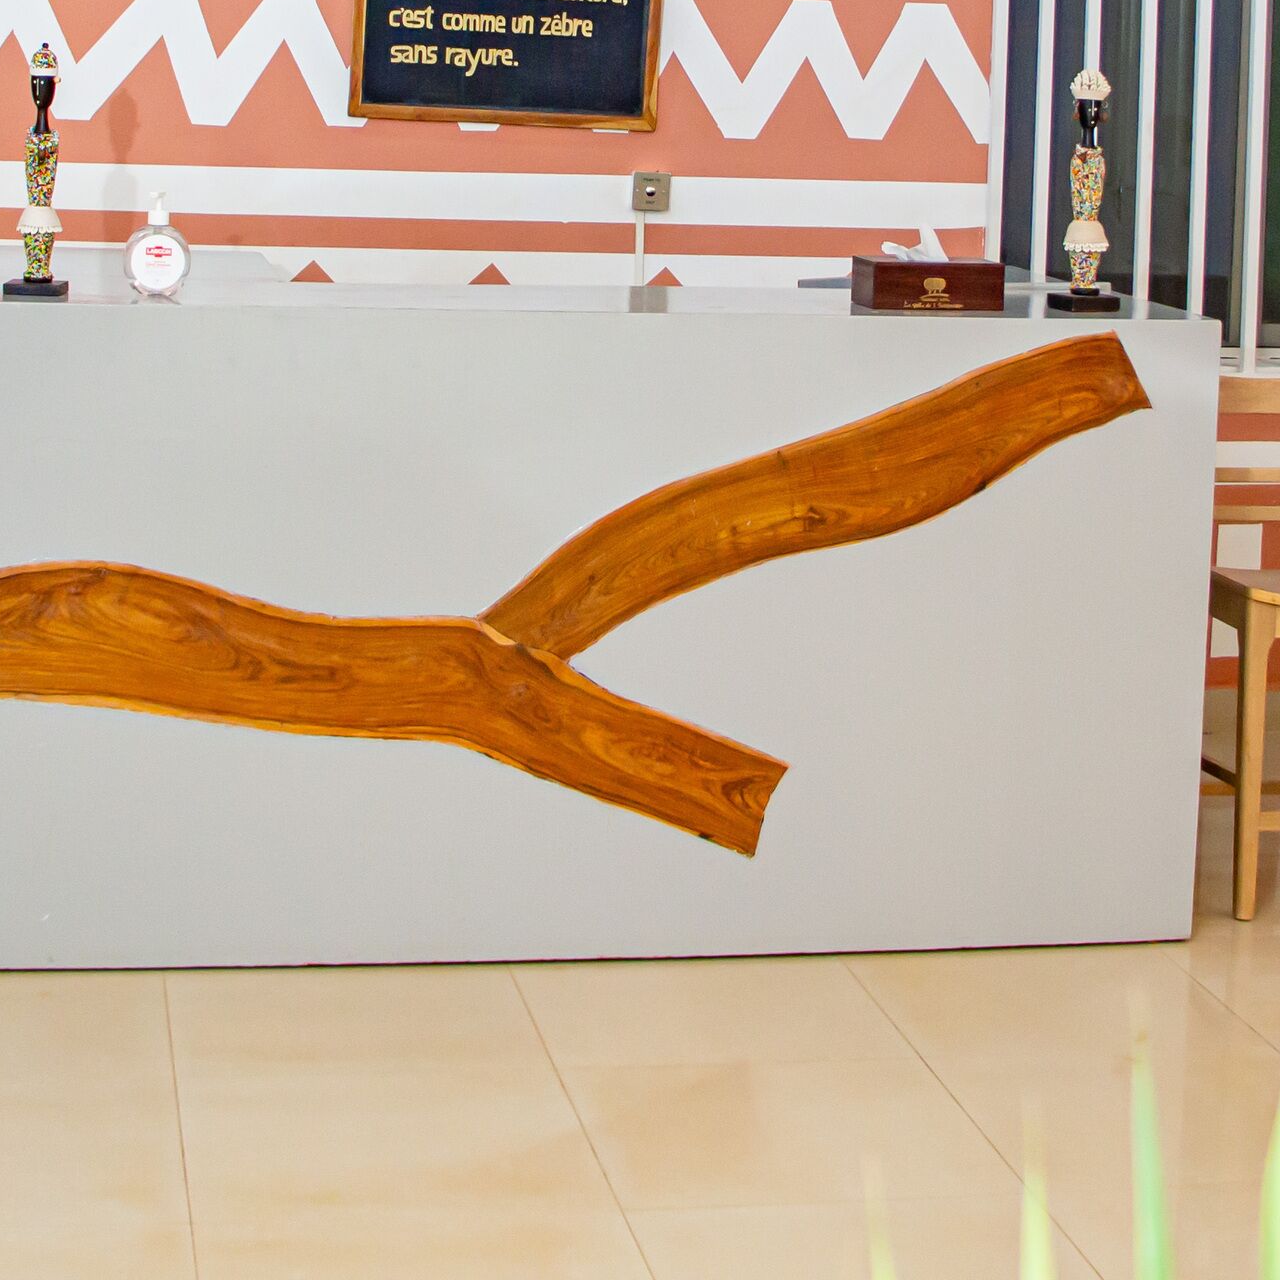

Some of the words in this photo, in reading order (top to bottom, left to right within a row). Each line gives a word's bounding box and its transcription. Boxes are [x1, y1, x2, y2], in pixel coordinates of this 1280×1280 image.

[388, 5, 435, 30] c'est
[441, 11, 507, 34] comme
[511, 14, 535, 35] un
[389, 43, 439, 65] sans
[444, 45, 519, 77] rayure.
